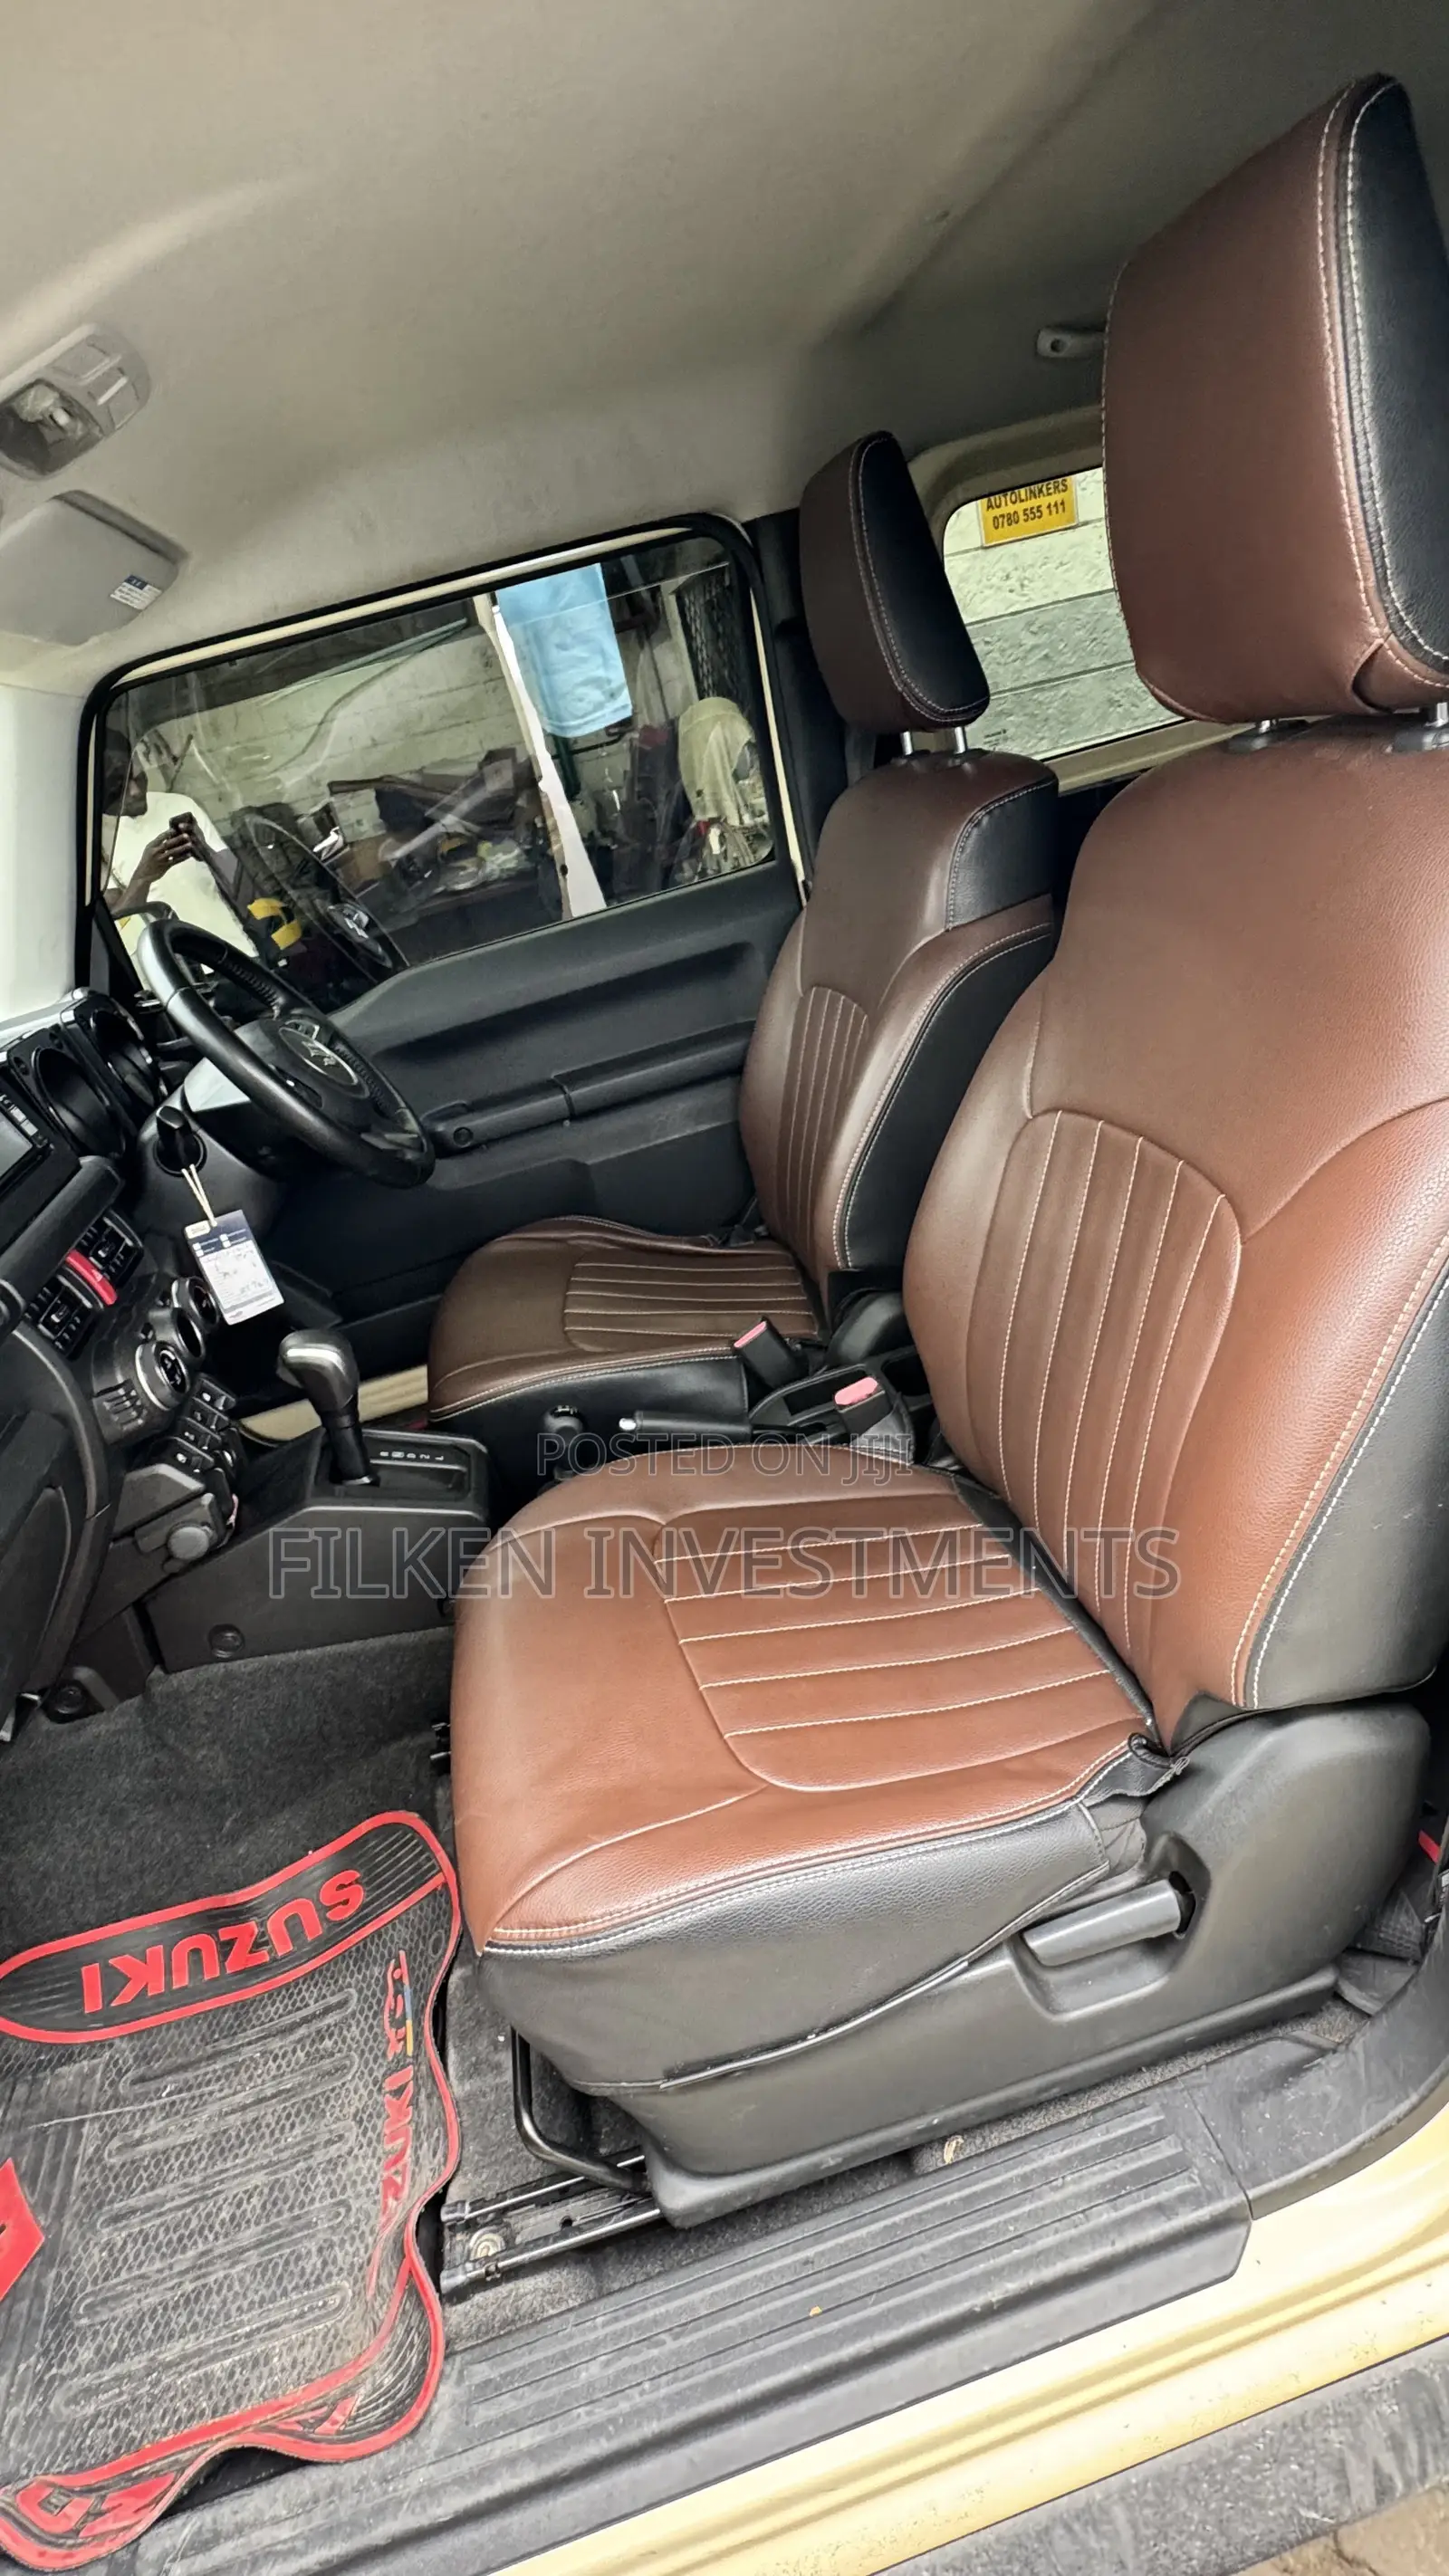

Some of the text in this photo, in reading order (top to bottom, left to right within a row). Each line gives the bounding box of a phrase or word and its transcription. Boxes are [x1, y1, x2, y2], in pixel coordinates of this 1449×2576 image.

[986, 479, 1069, 512] AUTOLINKERS
[993, 499, 1067, 531] 0780 555 111
[81, 1869, 364, 2014] SUZUKI
